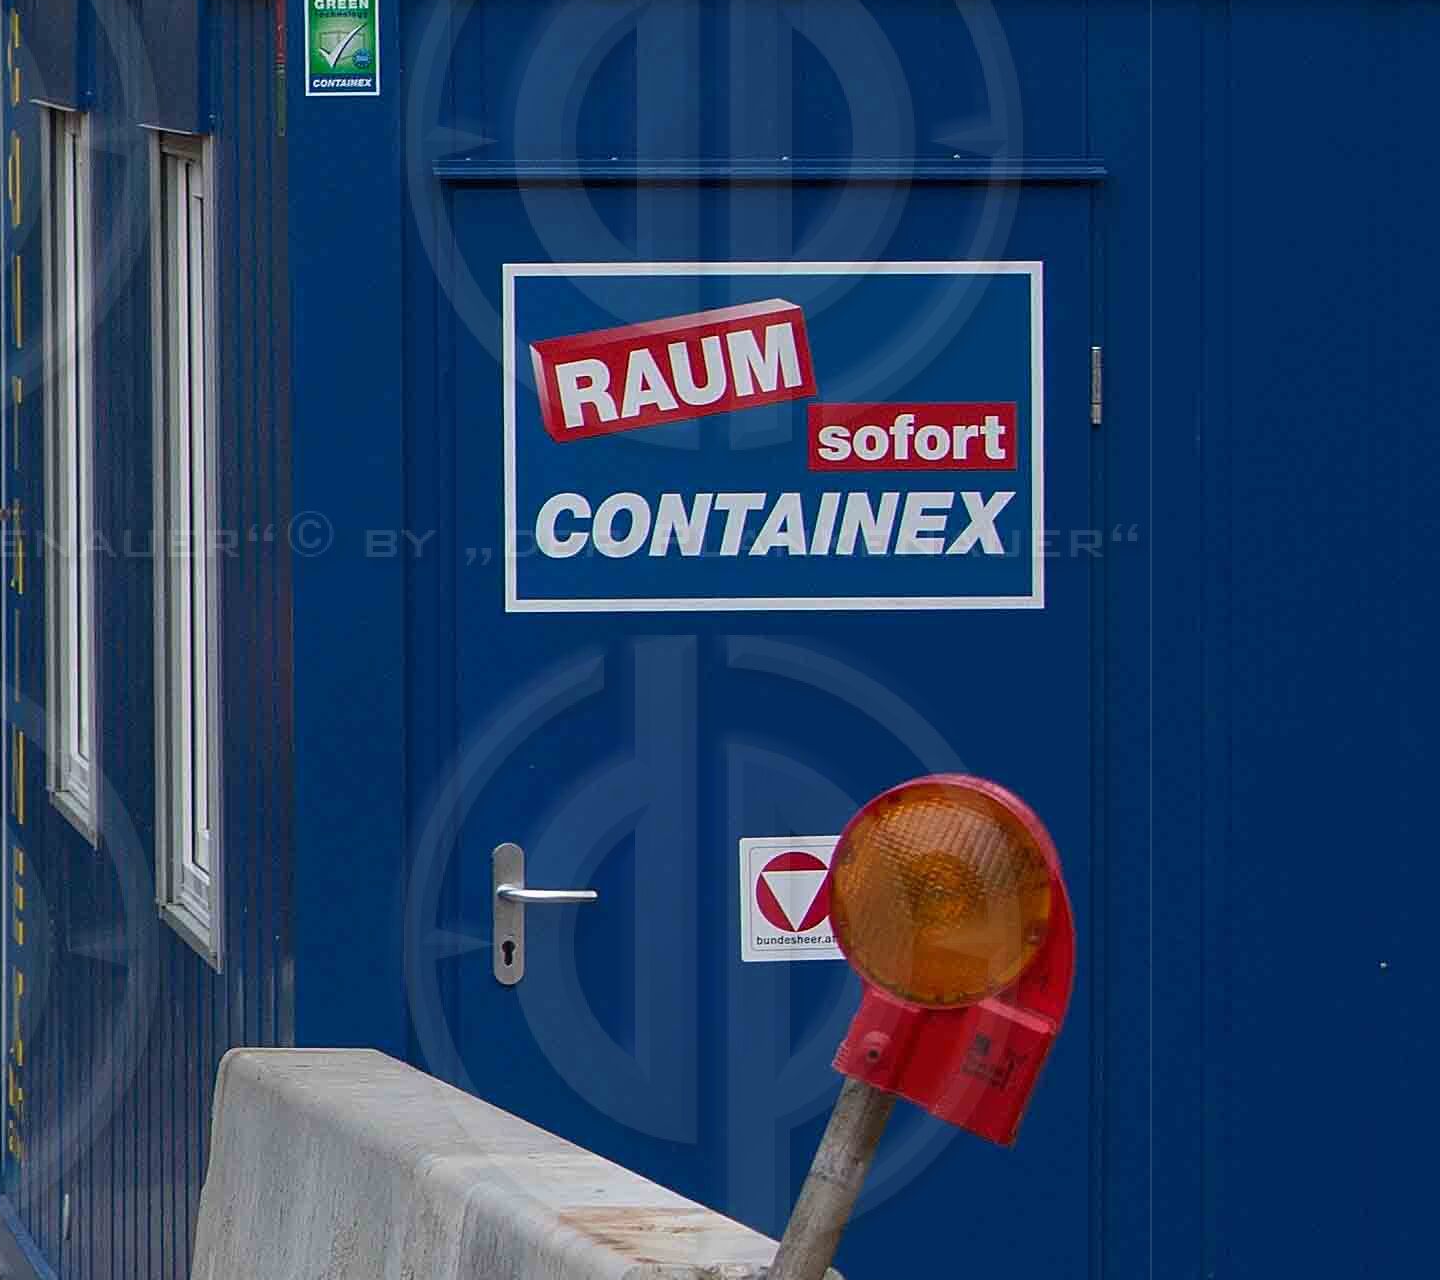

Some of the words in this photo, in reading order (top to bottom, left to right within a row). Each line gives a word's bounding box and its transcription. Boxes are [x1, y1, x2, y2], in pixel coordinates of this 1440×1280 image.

[312, 78, 373, 88] CONTAINEX
[554, 321, 803, 430] RAUM
[817, 414, 1007, 462] sofort
[535, 491, 1016, 559] CONTAINEX
